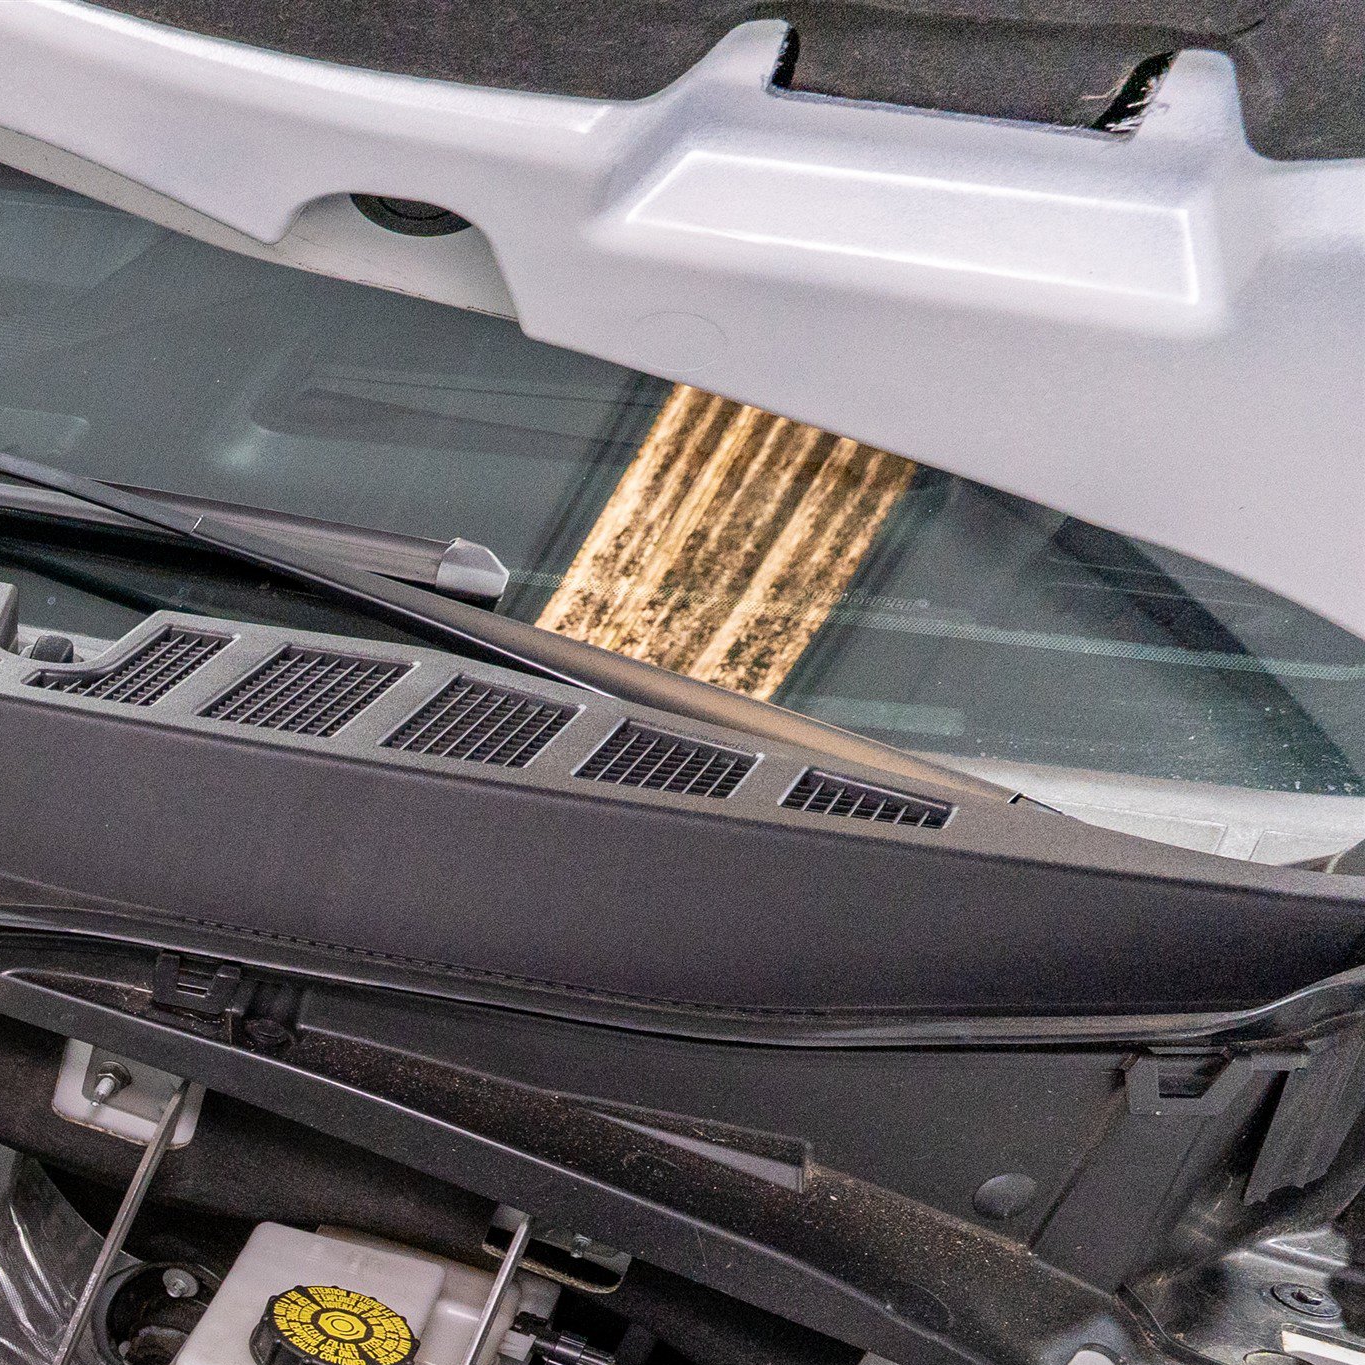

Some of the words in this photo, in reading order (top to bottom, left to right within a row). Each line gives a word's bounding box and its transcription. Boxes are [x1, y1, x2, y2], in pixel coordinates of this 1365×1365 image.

[307, 1287, 347, 1297] ATTENTION
[289, 1336, 319, 1355] SEALED
[301, 1324, 326, 1342] CLEAN
[326, 1338, 358, 1352] FILLER
[319, 1343, 336, 1355] USE
[338, 1349, 360, 1360] ONLY
